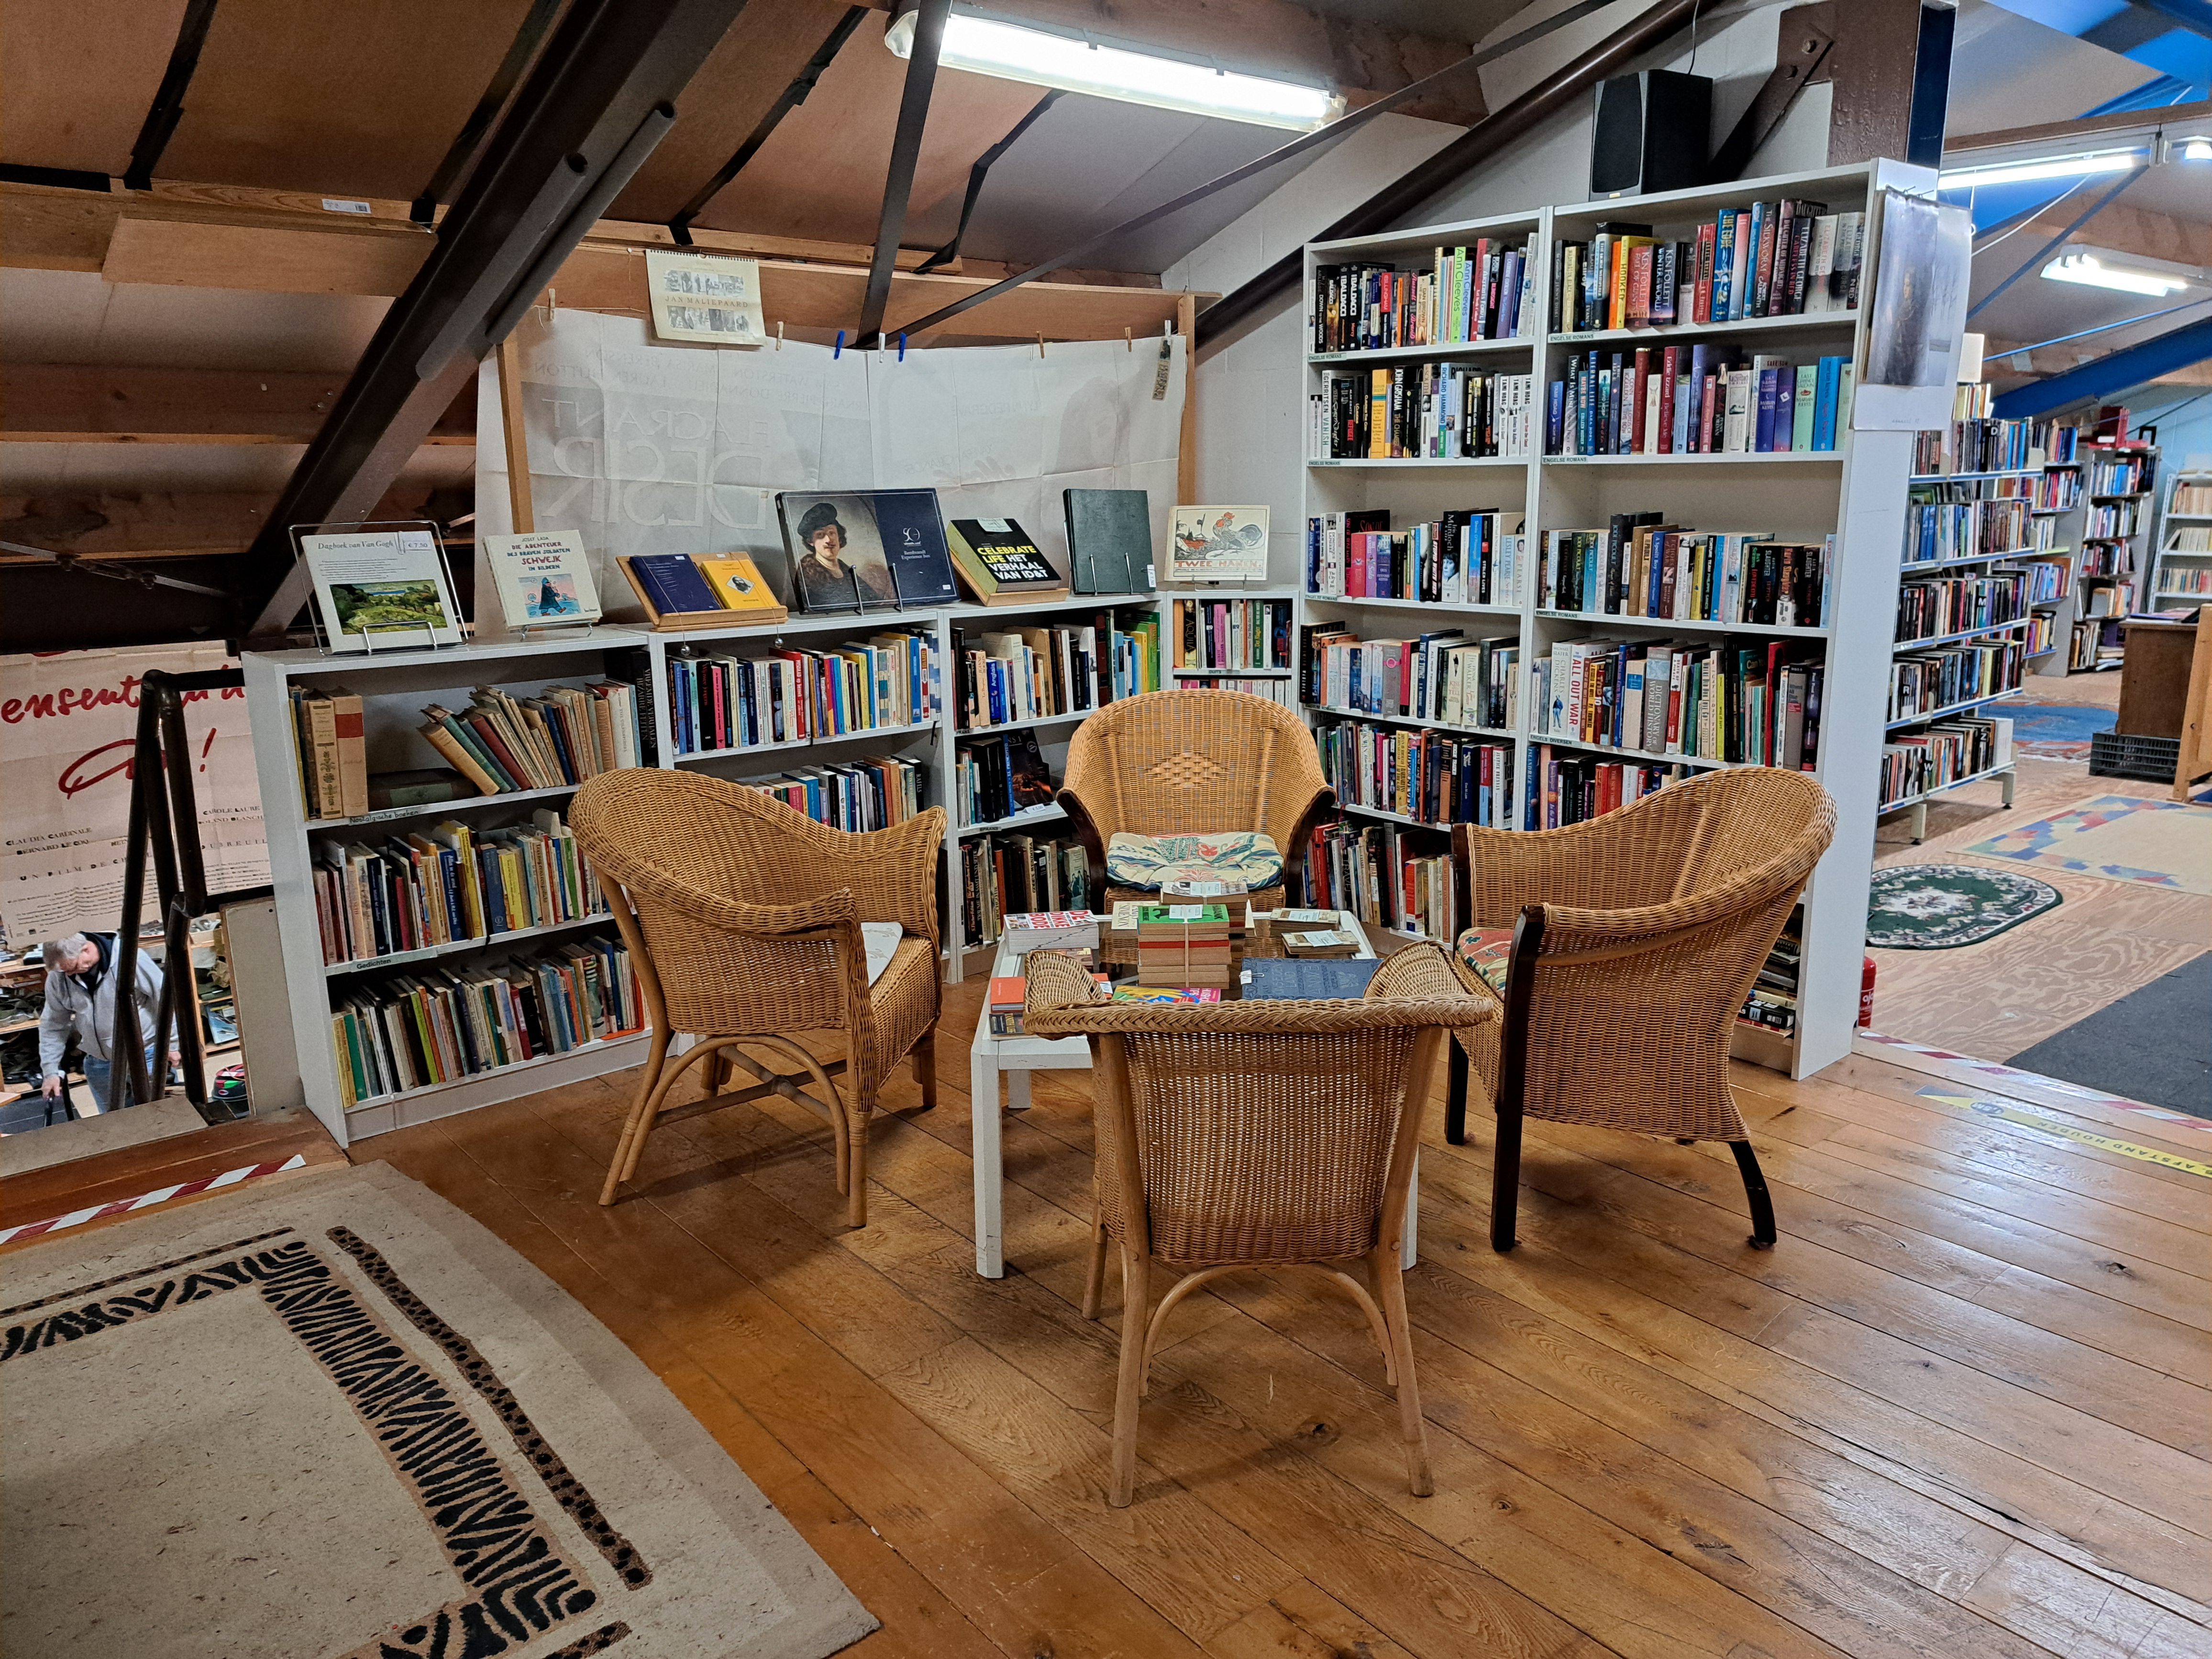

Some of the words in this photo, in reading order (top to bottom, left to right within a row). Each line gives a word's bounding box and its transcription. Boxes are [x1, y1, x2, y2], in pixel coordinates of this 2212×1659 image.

[1760, 223, 1773, 272] SILKWORM
[1799, 227, 1809, 270] ELIZABETH
[1456, 248, 1464, 269] Ann
[1641, 252, 1649, 270] KEN
[1657, 247, 1665, 278] WINTER
[1618, 264, 1627, 300] HOOKED
[1633, 271, 1639, 280] OF
[1454, 271, 1463, 311] Cleeves
[1638, 272, 1648, 311] FOLLETT
[1663, 269, 1672, 307] FOLLETT
[687, 297, 748, 308] MALIEPAARD
[1394, 369, 1403, 385] JOHN
[1991, 426, 1998, 435] D
[318, 542, 347, 550] Dagboek
[977, 546, 1037, 554] CELEBRATE
[982, 555, 1006, 563] LIFE
[988, 562, 1043, 571] VERHAAL
[1804, 552, 1813, 578] SLAUGHTER
[994, 571, 1021, 580] VAN
[1021, 570, 1048, 578] ID&T
[1781, 565, 1792, 594] Slaughter
[1978, 597, 1986, 607] M
[1185, 619, 1195, 651] AQUILA
[1572, 659, 1582, 676] ALL
[637, 678, 646, 711] BIZARRE
[644, 668, 653, 707] VREEMDE
[1571, 680, 1581, 700] OUT
[1903, 686, 1910, 695] R
[1594, 697, 1602, 706] 10
[1654, 685, 1663, 735] DICTIONARY
[1569, 702, 1579, 725] WAR
[647, 708, 656, 748] VERHALEN
[1646, 706, 1654, 748] HISTORY
[1653, 737, 1658, 745] OF
[1980, 732, 1987, 741] Z
[1924, 762, 1933, 771] W
[350, 812, 392, 824] Nostalgische
[394, 810, 418, 818] boeken
[5, 835, 45, 846] CLAUDIA
[47, 827, 92, 840] CARDINALE
[16, 842, 59, 855] BERNARD
[20, 874, 39, 882] UN
[47, 866, 81, 877] FILM
[90, 861, 106, 870] DE
[1029, 913, 1051, 929] BODE
[1050, 911, 1070, 929] DIKKE
[1069, 910, 1089, 922] DE
[1118, 904, 1130, 928] SIMENON
[1212, 905, 1224, 920] HAVANK
[357, 958, 391, 970] Gedichten
[2037, 1121, 2105, 1144] HOUDEN
[2113, 1142, 2195, 1169] AFSTAND
